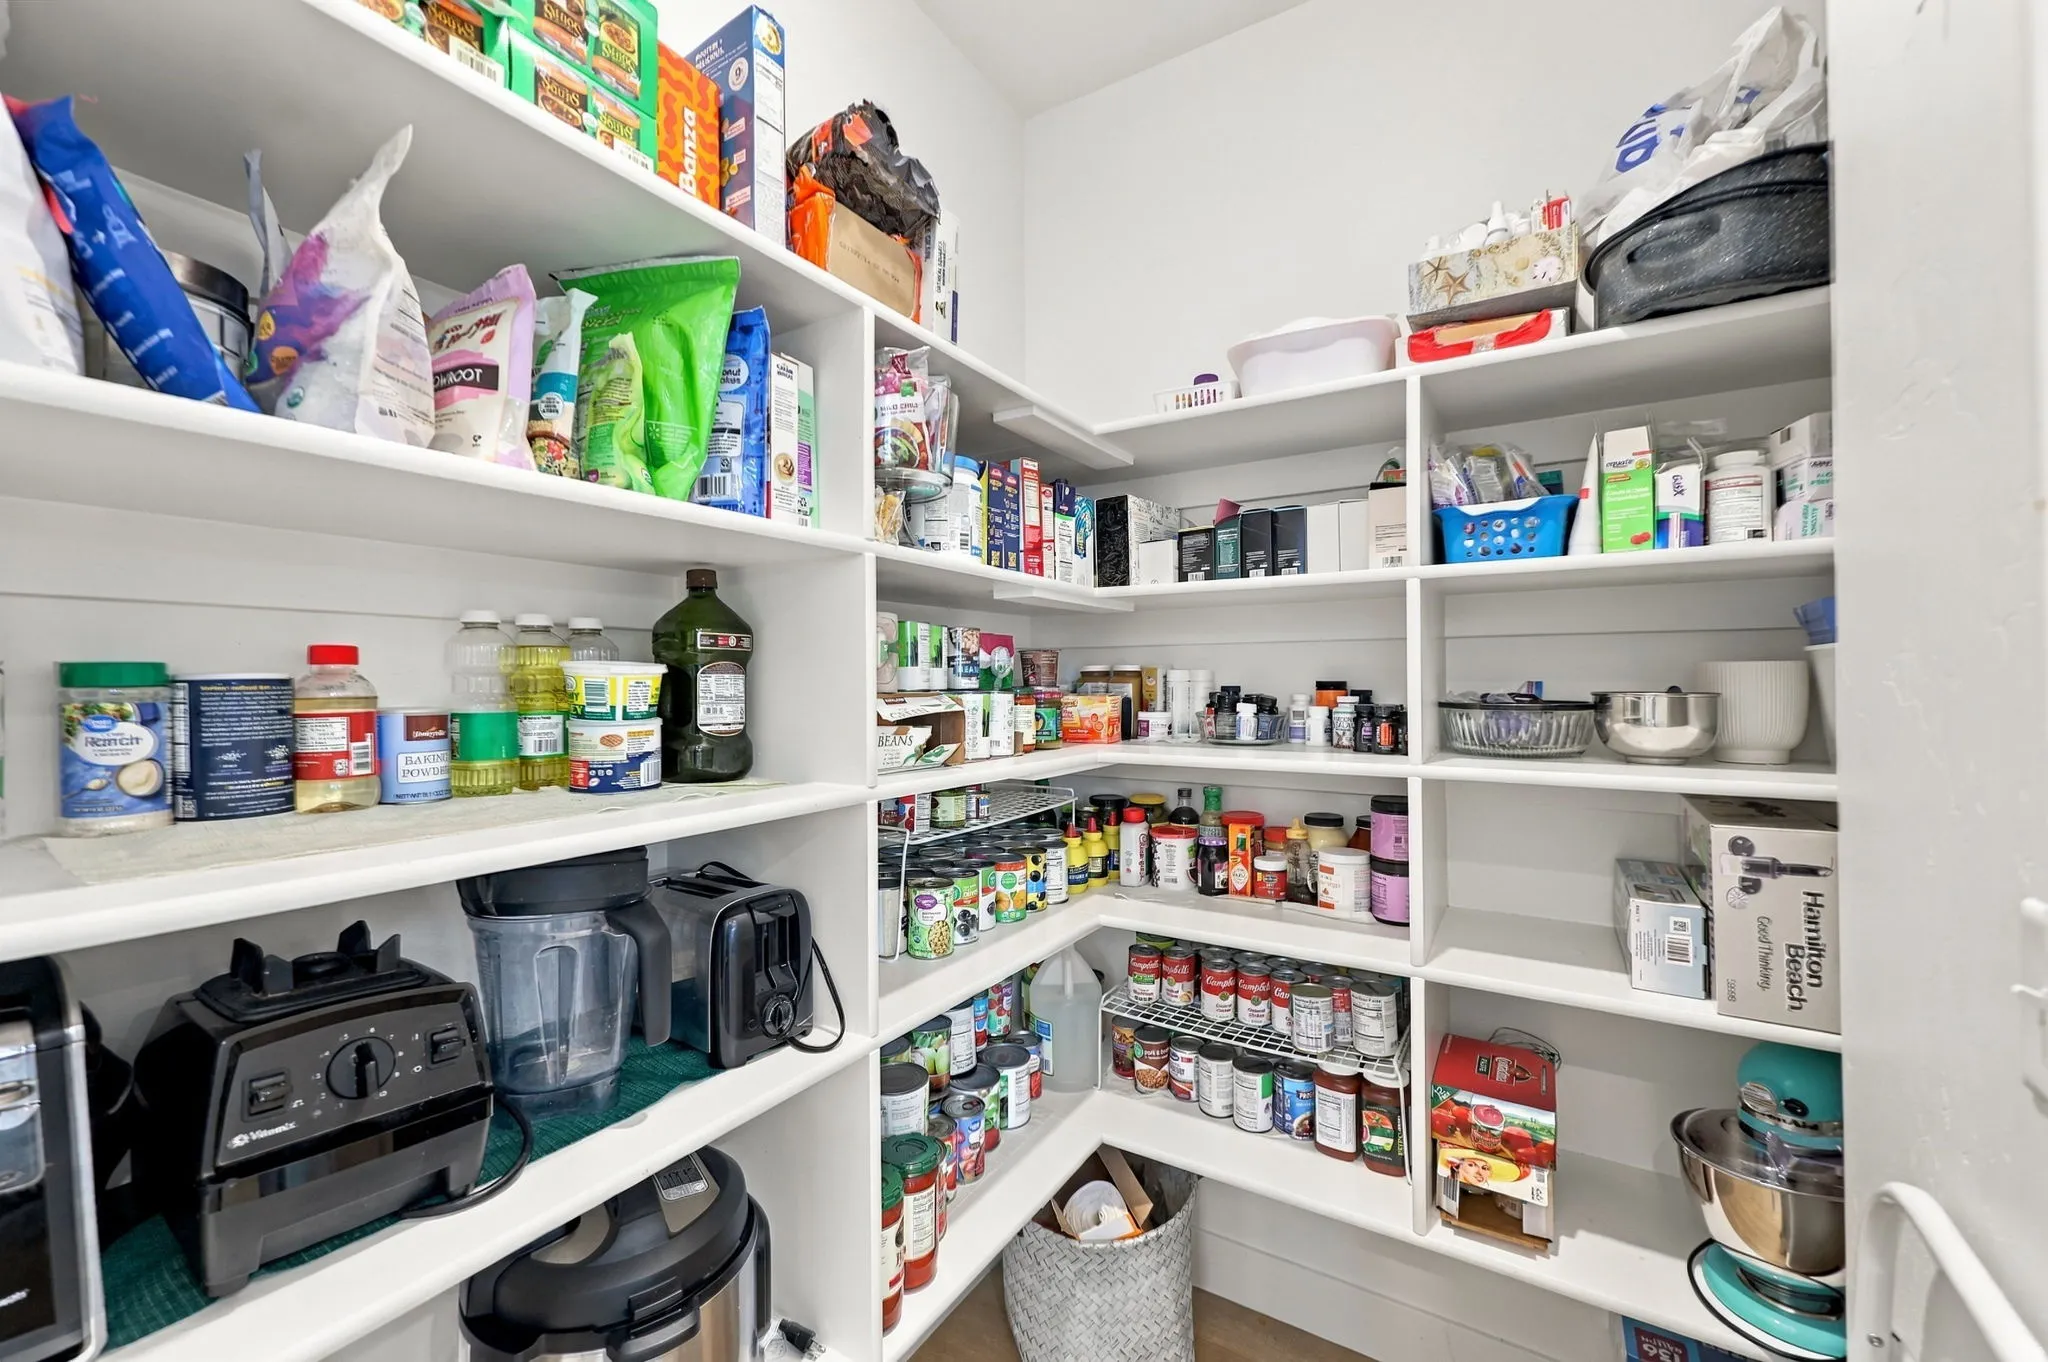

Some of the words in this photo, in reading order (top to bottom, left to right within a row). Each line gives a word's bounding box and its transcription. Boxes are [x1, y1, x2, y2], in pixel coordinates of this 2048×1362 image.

[678, 107, 697, 196] Banza
[722, 367, 741, 378] onut
[84, 734, 140, 748] Ranch
[878, 734, 914, 748] BEANS
[1803, 890, 1826, 988] Hamilton
[1785, 943, 1808, 1011] Beach
